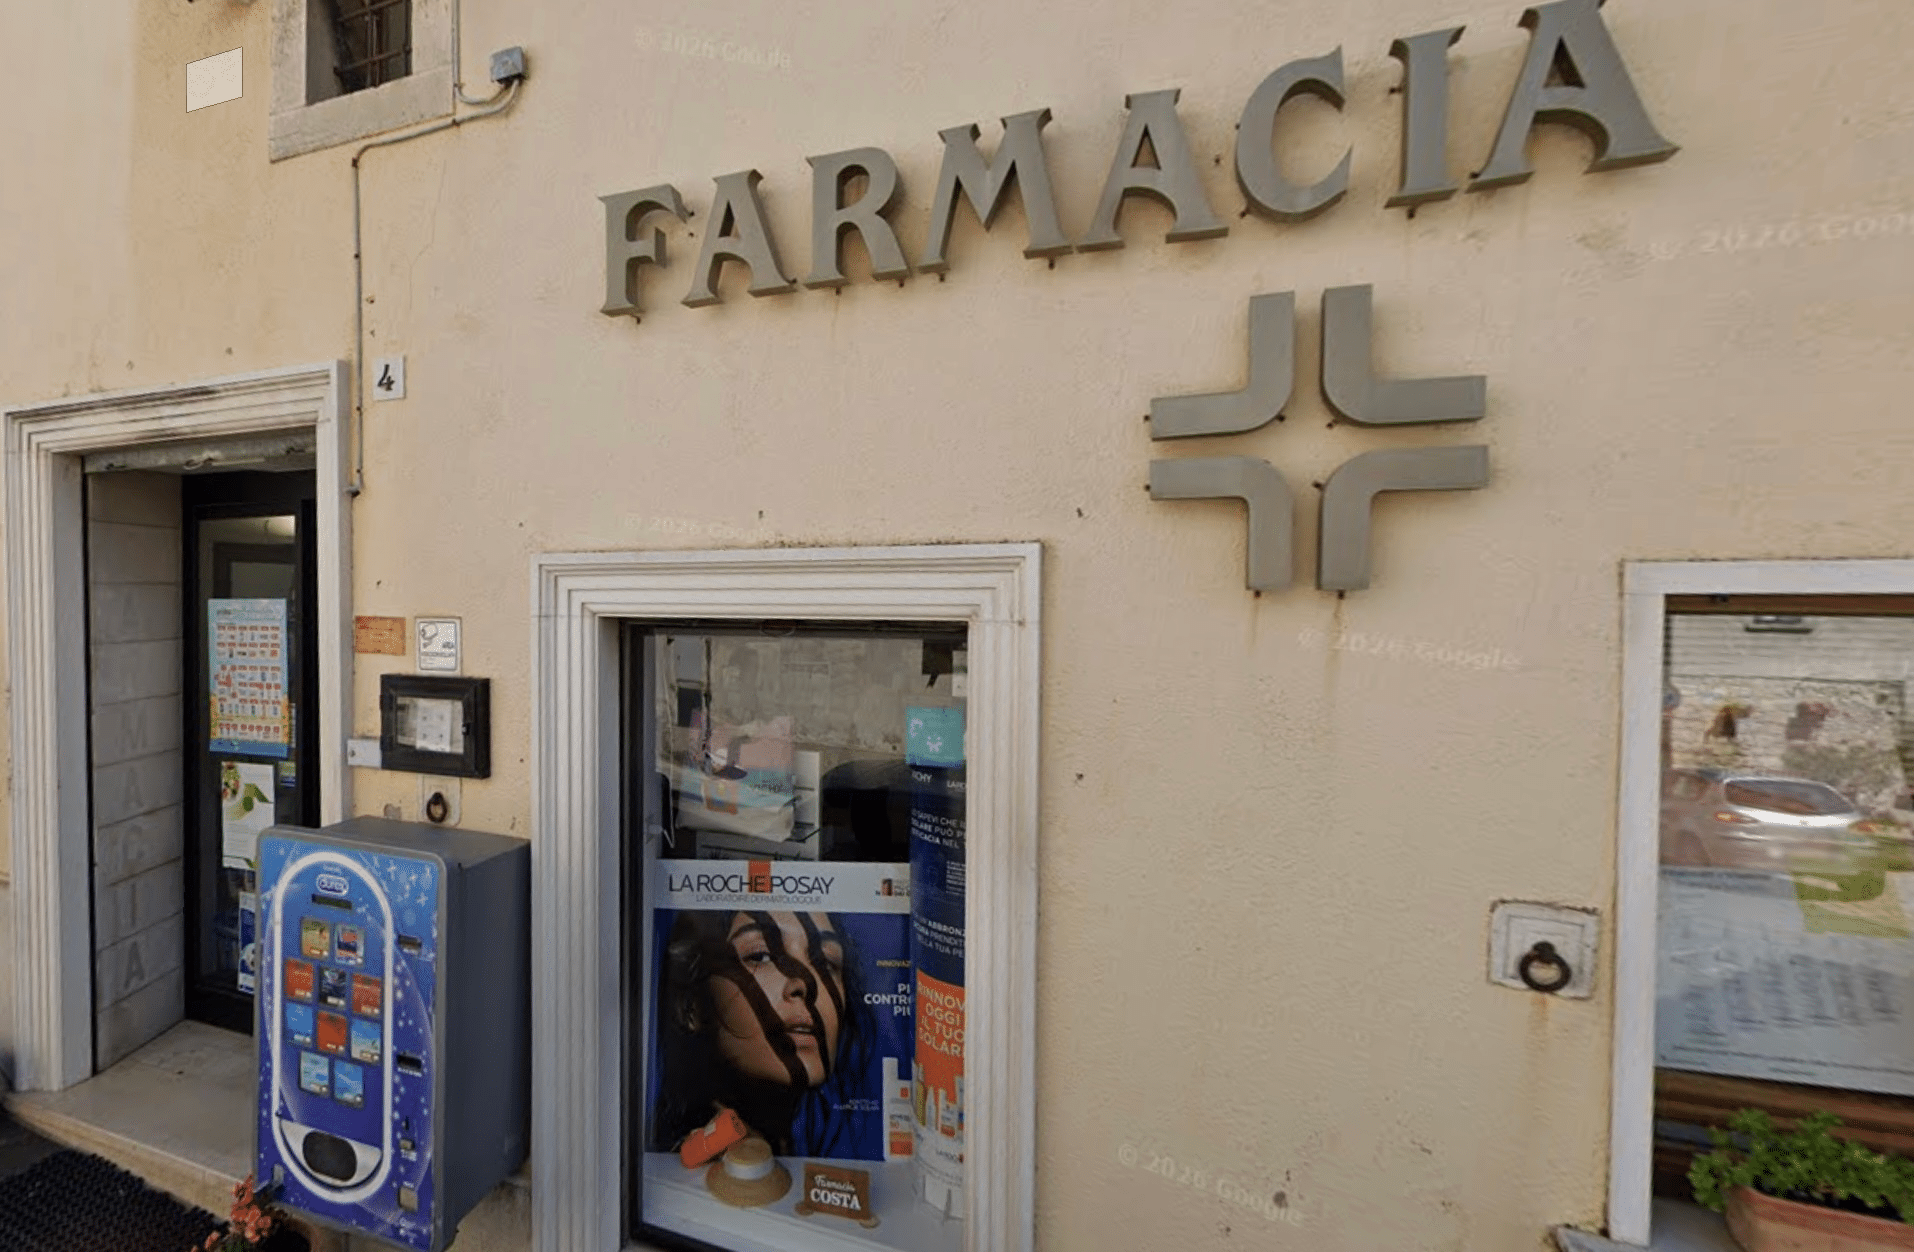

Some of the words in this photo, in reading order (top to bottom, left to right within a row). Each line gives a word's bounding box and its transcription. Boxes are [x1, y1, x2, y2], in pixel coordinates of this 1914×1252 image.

[598, 0, 1680, 316] FARMACIA
[377, 363, 396, 392] 4
[668, 874, 694, 893] LA
[696, 874, 766, 894] ROCHE
[770, 876, 835, 895] POSAY
[918, 981, 966, 1012] RINNOV
[925, 1002, 960, 1027] OGGI
[918, 1027, 965, 1057] SOLAR
[934, 1021, 965, 1043] TUO
[810, 1188, 862, 1211] COSTA
